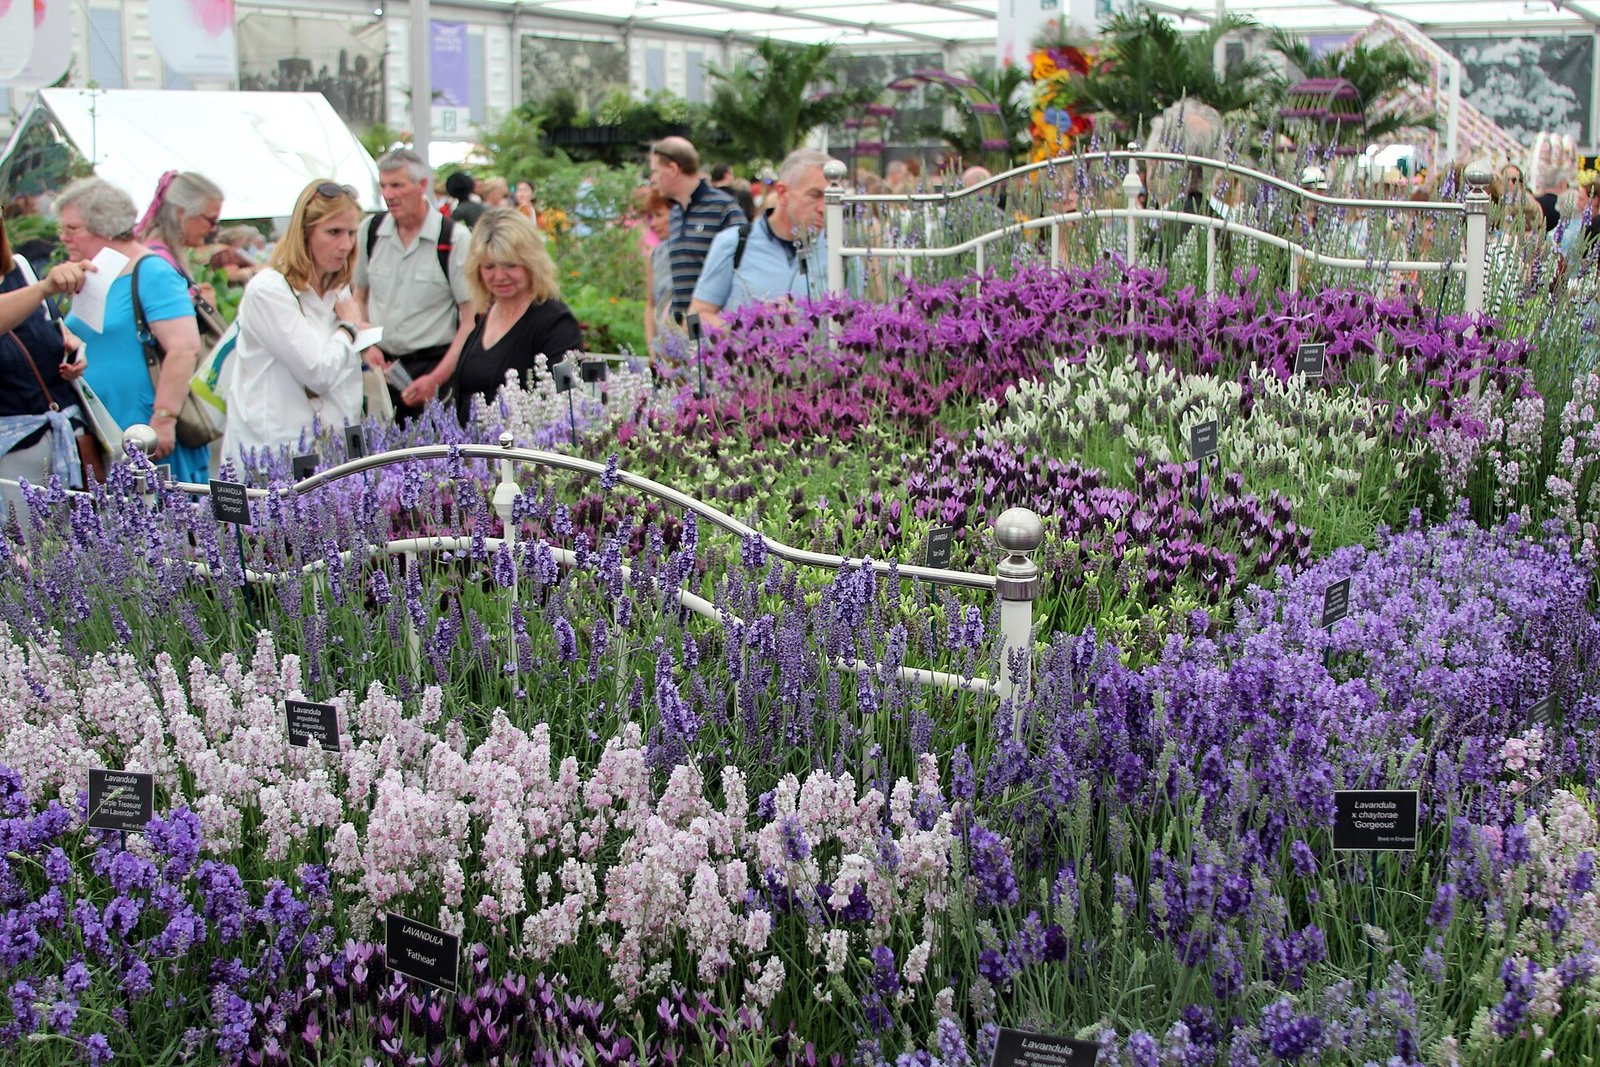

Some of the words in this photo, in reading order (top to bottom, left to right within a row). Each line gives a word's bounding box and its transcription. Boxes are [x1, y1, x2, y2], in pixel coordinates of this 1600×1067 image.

[293, 706, 322, 716] Lavandula
[104, 774, 138, 784] Lavandula
[1354, 801, 1396, 809] Lavandula
[1358, 811, 1399, 820] chaytorae
[402, 925, 443, 946] LAVANDULA
[406, 947, 437, 966] 'Fathead'
[1021, 1038, 1073, 1055] Lavandula
[1024, 1051, 1066, 1064] angustifolia
